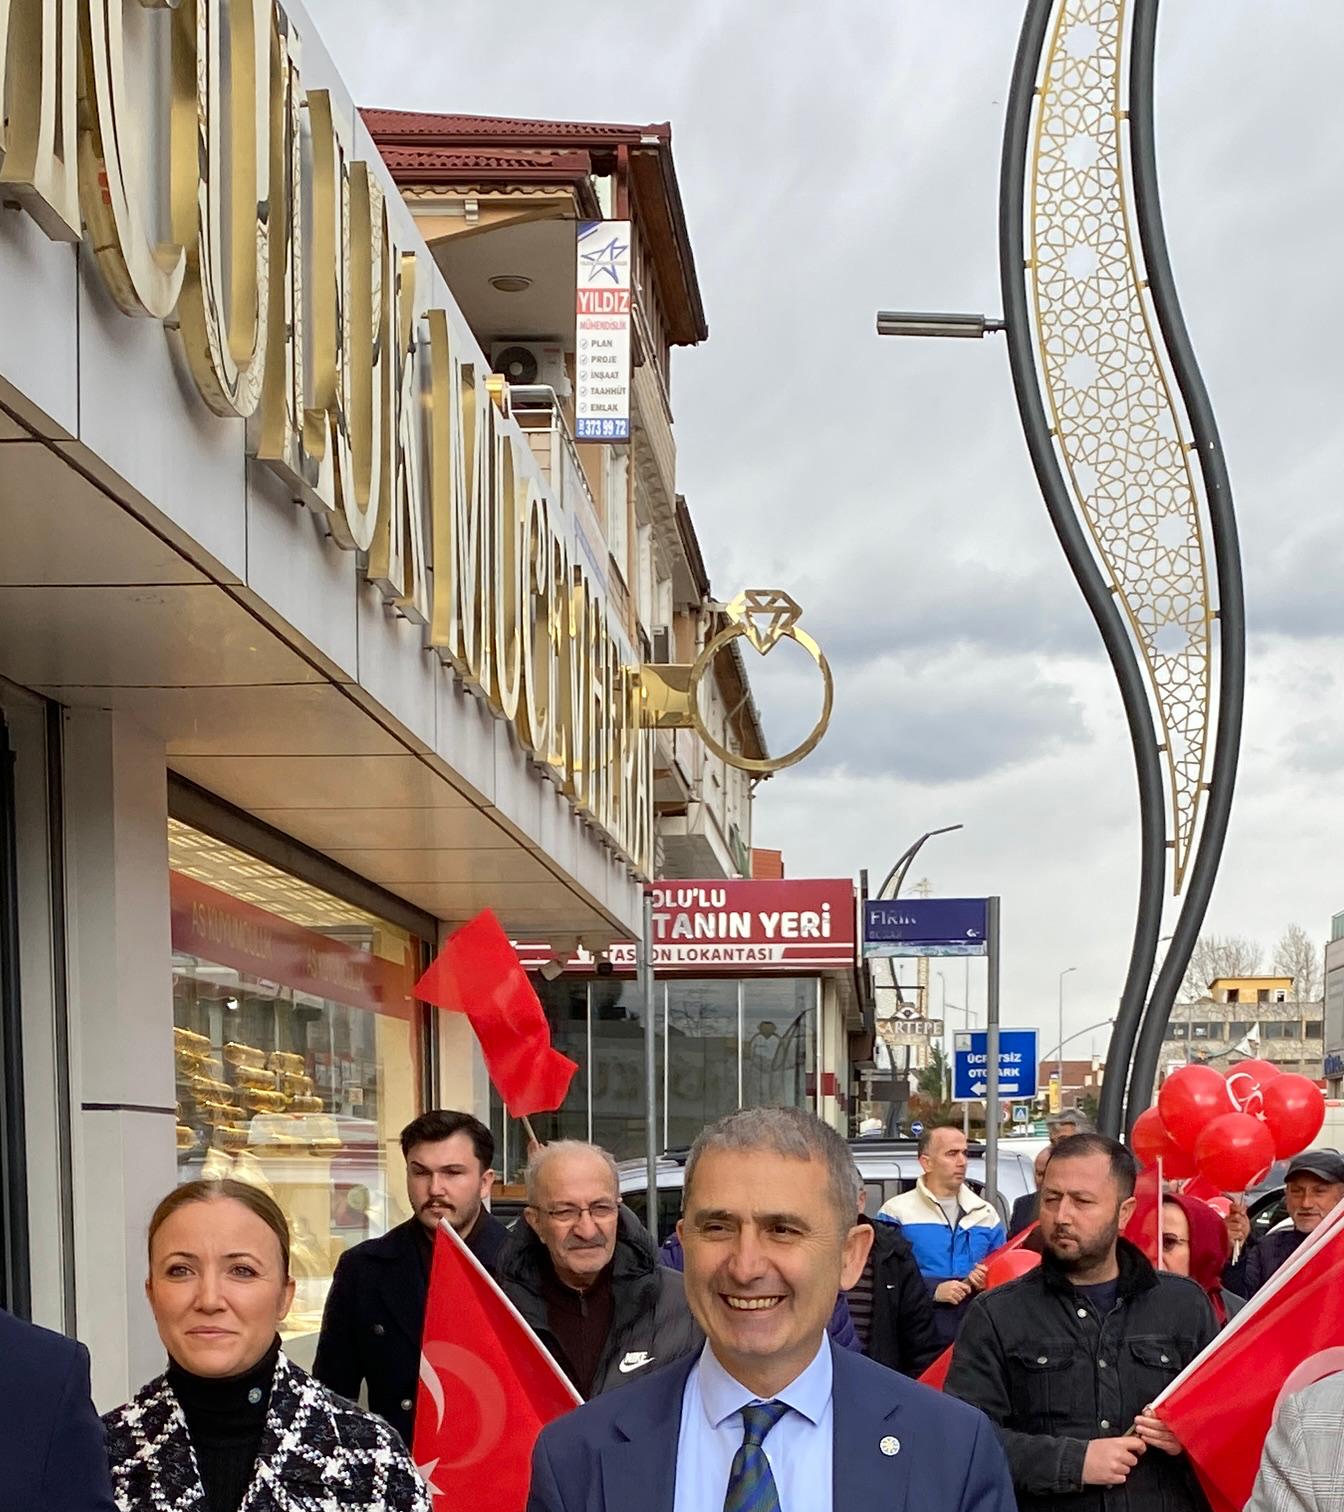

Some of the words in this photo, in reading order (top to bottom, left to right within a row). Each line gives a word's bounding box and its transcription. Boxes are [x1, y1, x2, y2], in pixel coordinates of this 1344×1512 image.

[578, 291, 630, 313] YILDIZ
[590, 339, 613, 348] PLAN
[590, 355, 617, 364] PROJE
[589, 403, 619, 413] EMLAK
[585, 420, 601, 436] 373
[616, 420, 626, 436] 72
[677, 948, 773, 961] LOKANTASI
[967, 1052, 1022, 1064] ÜCTSİZ
[968, 1068, 1020, 1078] OTOARK
